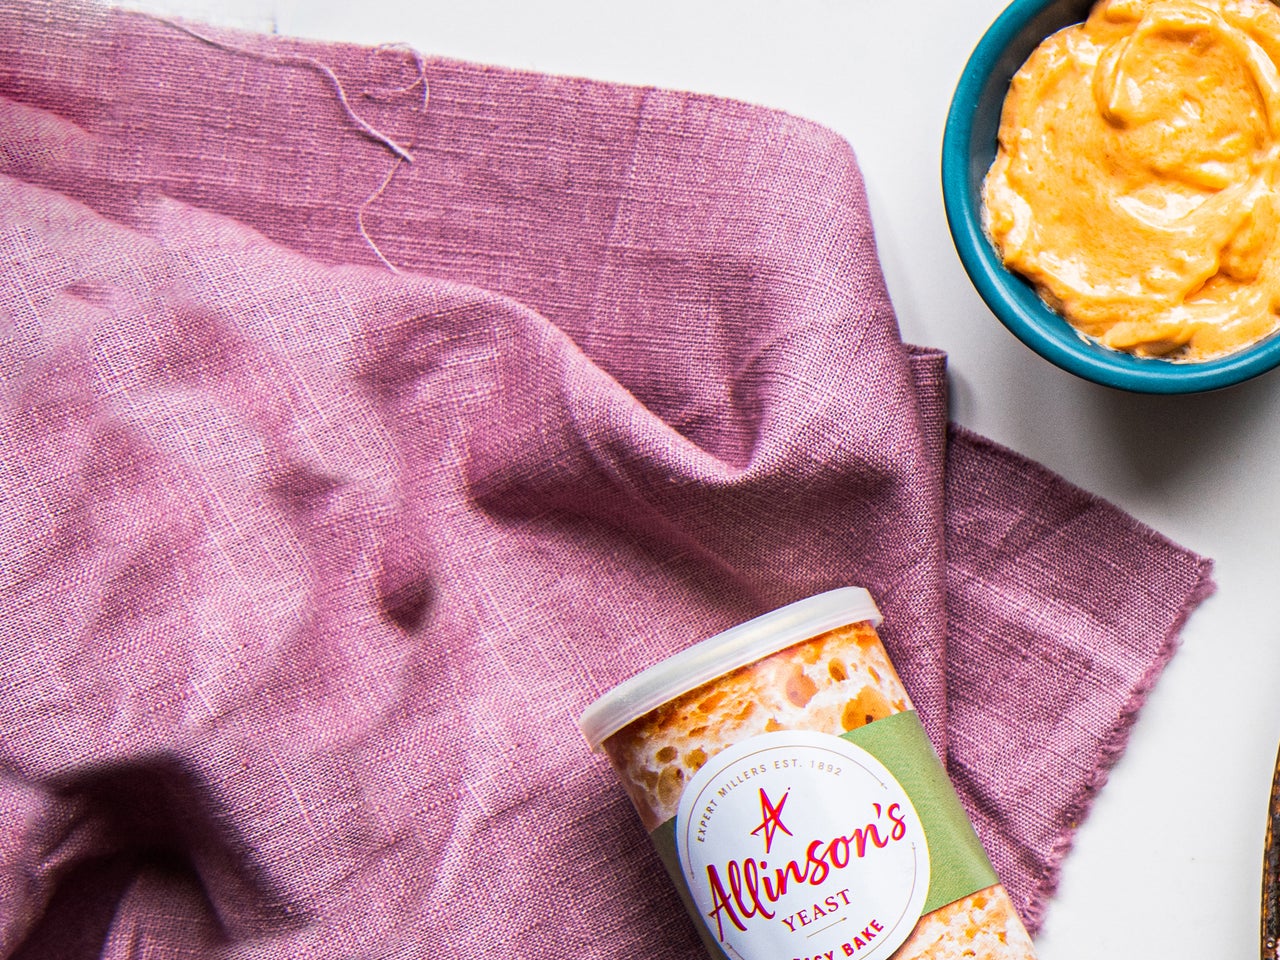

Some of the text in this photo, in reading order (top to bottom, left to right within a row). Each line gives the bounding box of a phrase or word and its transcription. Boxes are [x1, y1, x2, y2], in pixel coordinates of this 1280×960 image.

[697, 758, 842, 842] EXPERT MILLERS EST. 1892
[707, 802, 907, 943] Allinson's
[782, 889, 852, 933] YEAST
[842, 919, 884, 956] BAKE
